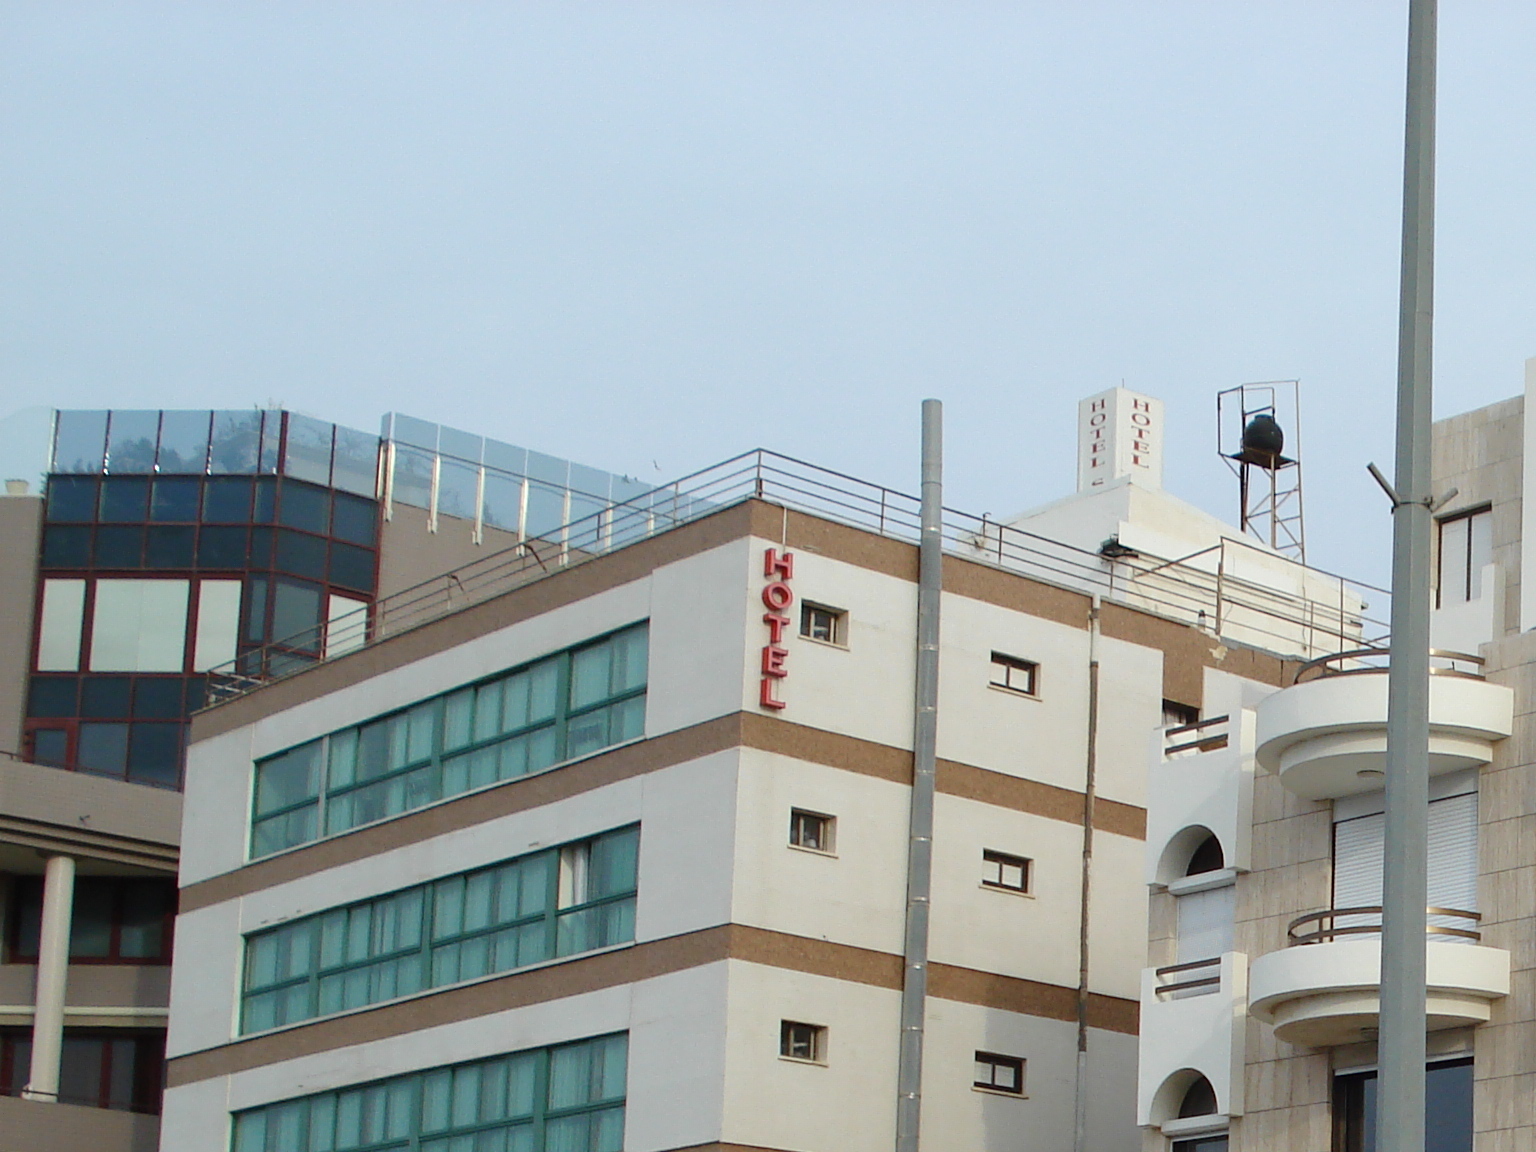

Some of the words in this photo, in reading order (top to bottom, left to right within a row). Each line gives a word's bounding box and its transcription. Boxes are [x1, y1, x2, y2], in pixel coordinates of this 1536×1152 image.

[1089, 398, 1106, 468] HOTEL
[1131, 397, 1151, 469] HOTEL
[760, 547, 794, 711] HOTEL
